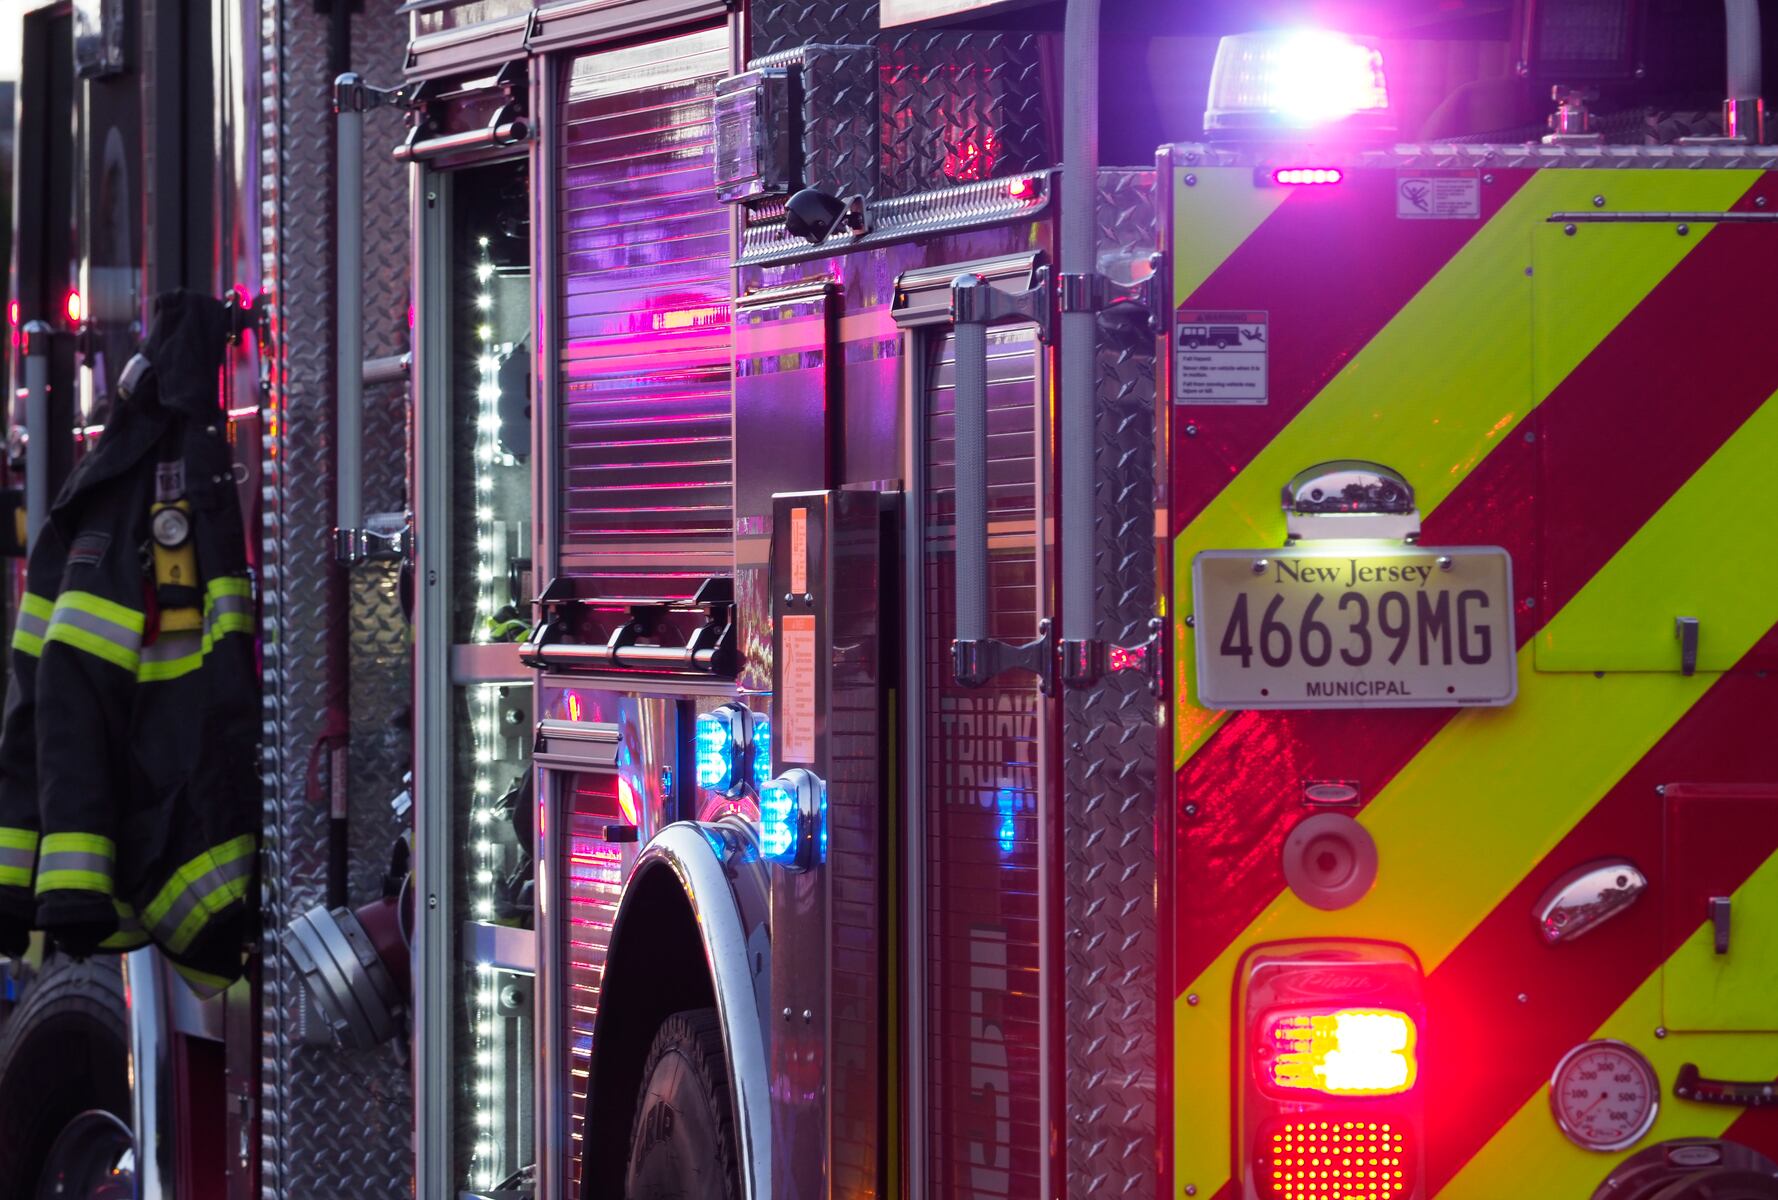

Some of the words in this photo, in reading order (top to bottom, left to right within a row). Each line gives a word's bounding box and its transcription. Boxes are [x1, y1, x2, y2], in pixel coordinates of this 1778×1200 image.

[1274, 559, 1340, 584] New
[1346, 559, 1433, 588] Jersey
[1220, 589, 1492, 668] 46639MG
[1306, 681, 1412, 697] MUNICIPAL
[941, 693, 1036, 809] TRUCK
[1598, 1062, 1615, 1072] 300
[1580, 1071, 1598, 1080] 200
[1614, 1074, 1632, 1083] 400
[1572, 1089, 1588, 1098] 100
[1618, 1092, 1636, 1102] 500
[1609, 1111, 1628, 1120] 600
